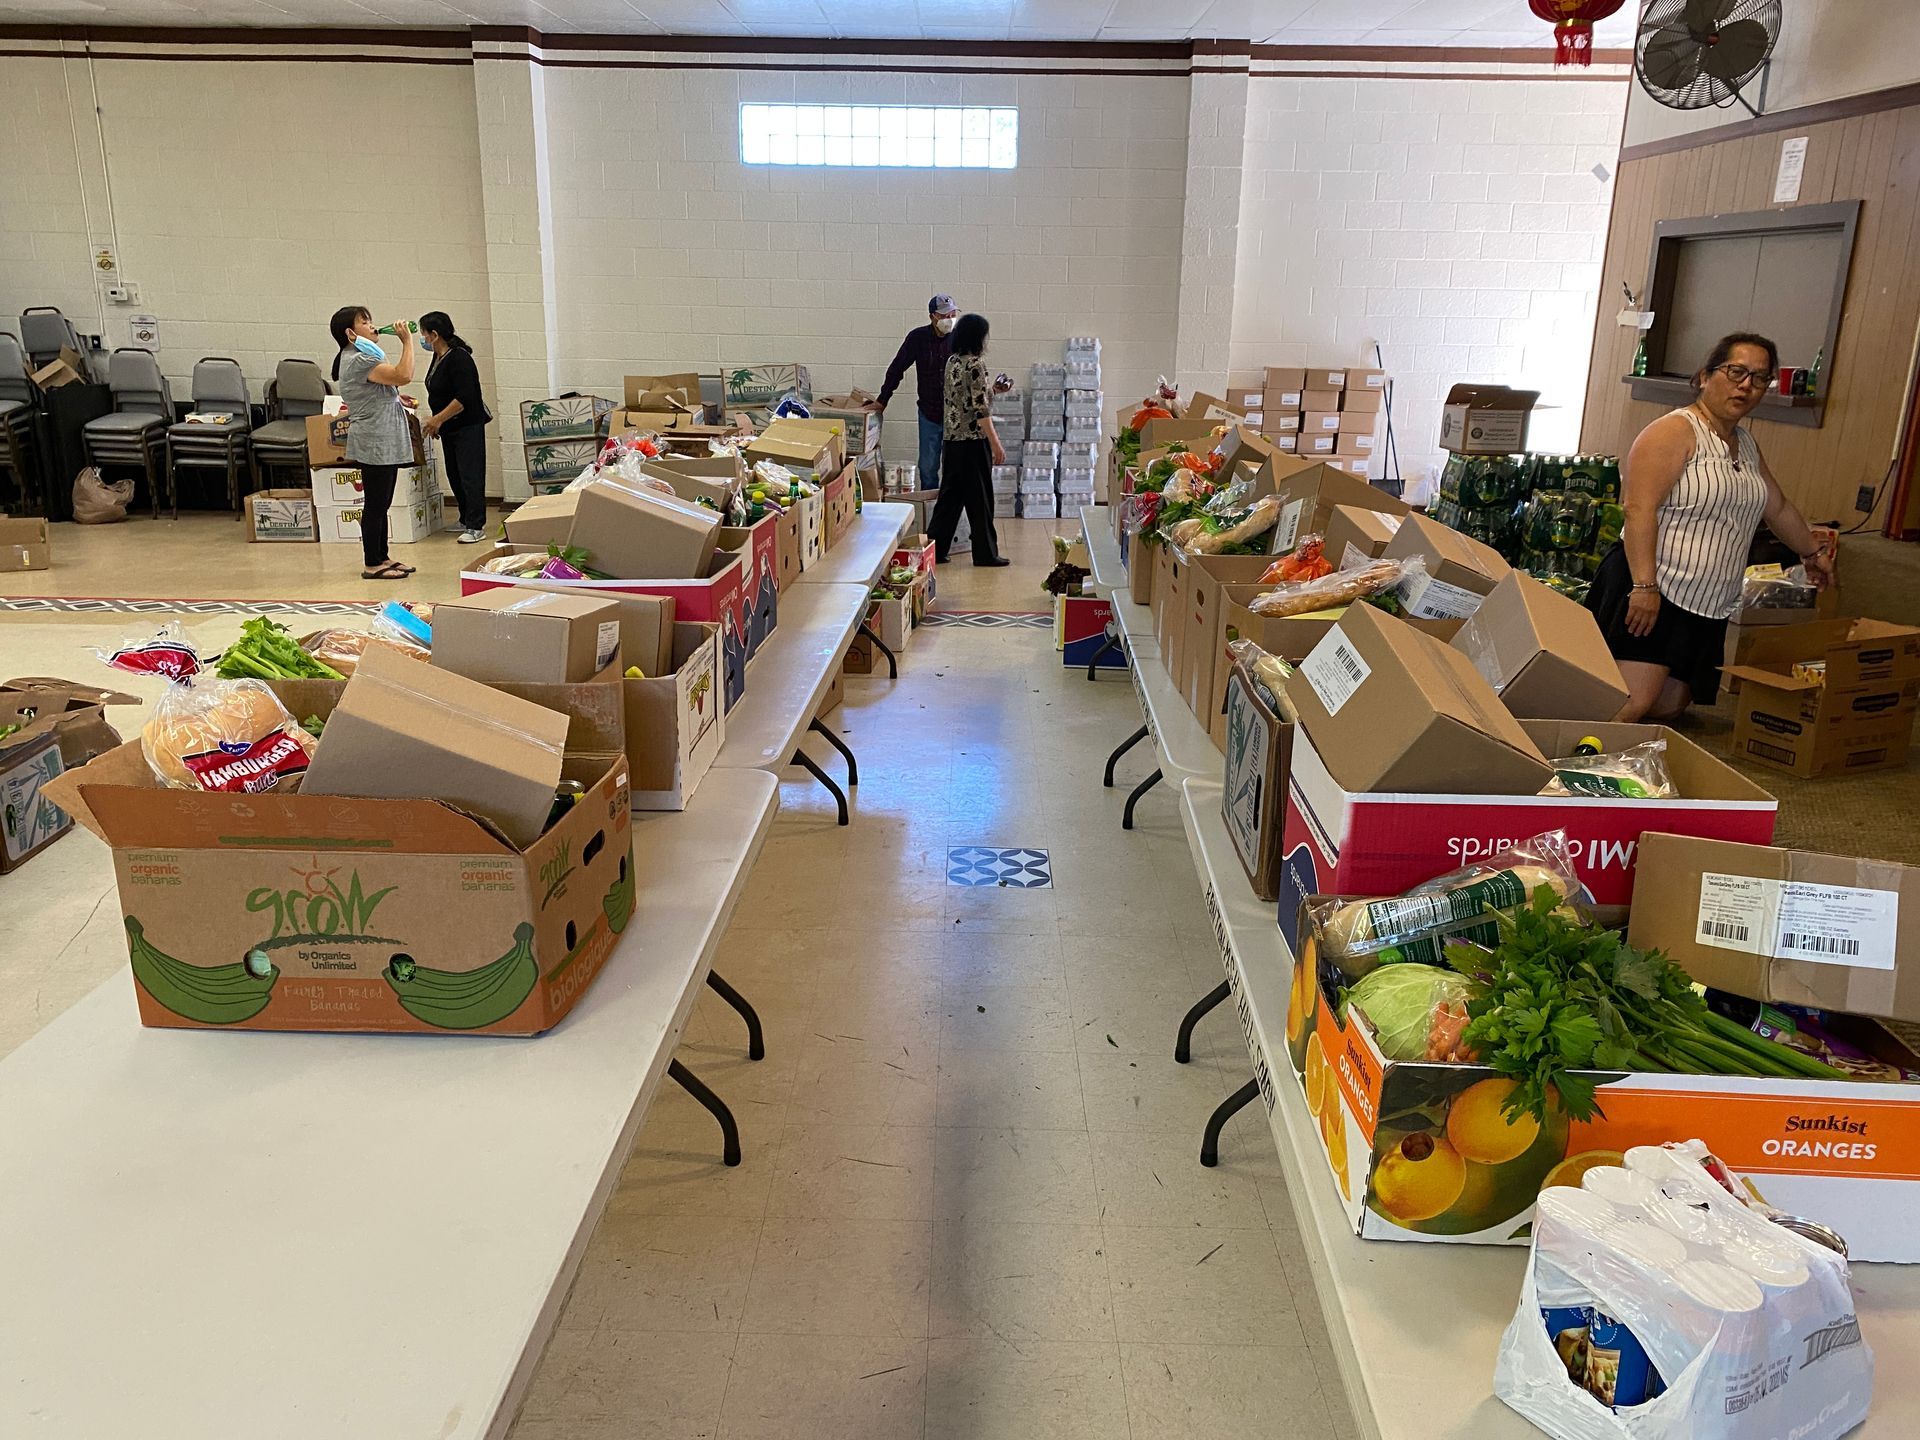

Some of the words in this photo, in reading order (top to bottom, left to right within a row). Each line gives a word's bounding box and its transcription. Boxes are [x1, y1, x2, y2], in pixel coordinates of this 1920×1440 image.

[743, 384, 778, 394] DESTINY
[541, 416, 575, 427] DESTINY
[545, 459, 579, 470] DESTINY
[127, 853, 178, 863] premium
[130, 863, 179, 876] organic
[460, 859, 513, 870] premium
[131, 874, 182, 886] bananas
[462, 869, 513, 882] organic
[462, 880, 515, 892] bananas
[298, 950, 310, 961] by
[310, 951, 351, 961] Organics
[311, 961, 357, 970] Unlimited
[550, 928, 614, 1013] biologique
[283, 985, 325, 999] Fairly
[335, 986, 384, 1000] Traded
[310, 999, 361, 1012] Bananas
[1347, 1038, 1371, 1093] Sunkist
[1339, 1054, 1374, 1123] ORANGES
[1784, 1115, 1868, 1137] Sunkist
[1761, 1139, 1878, 1160] ORANGES
